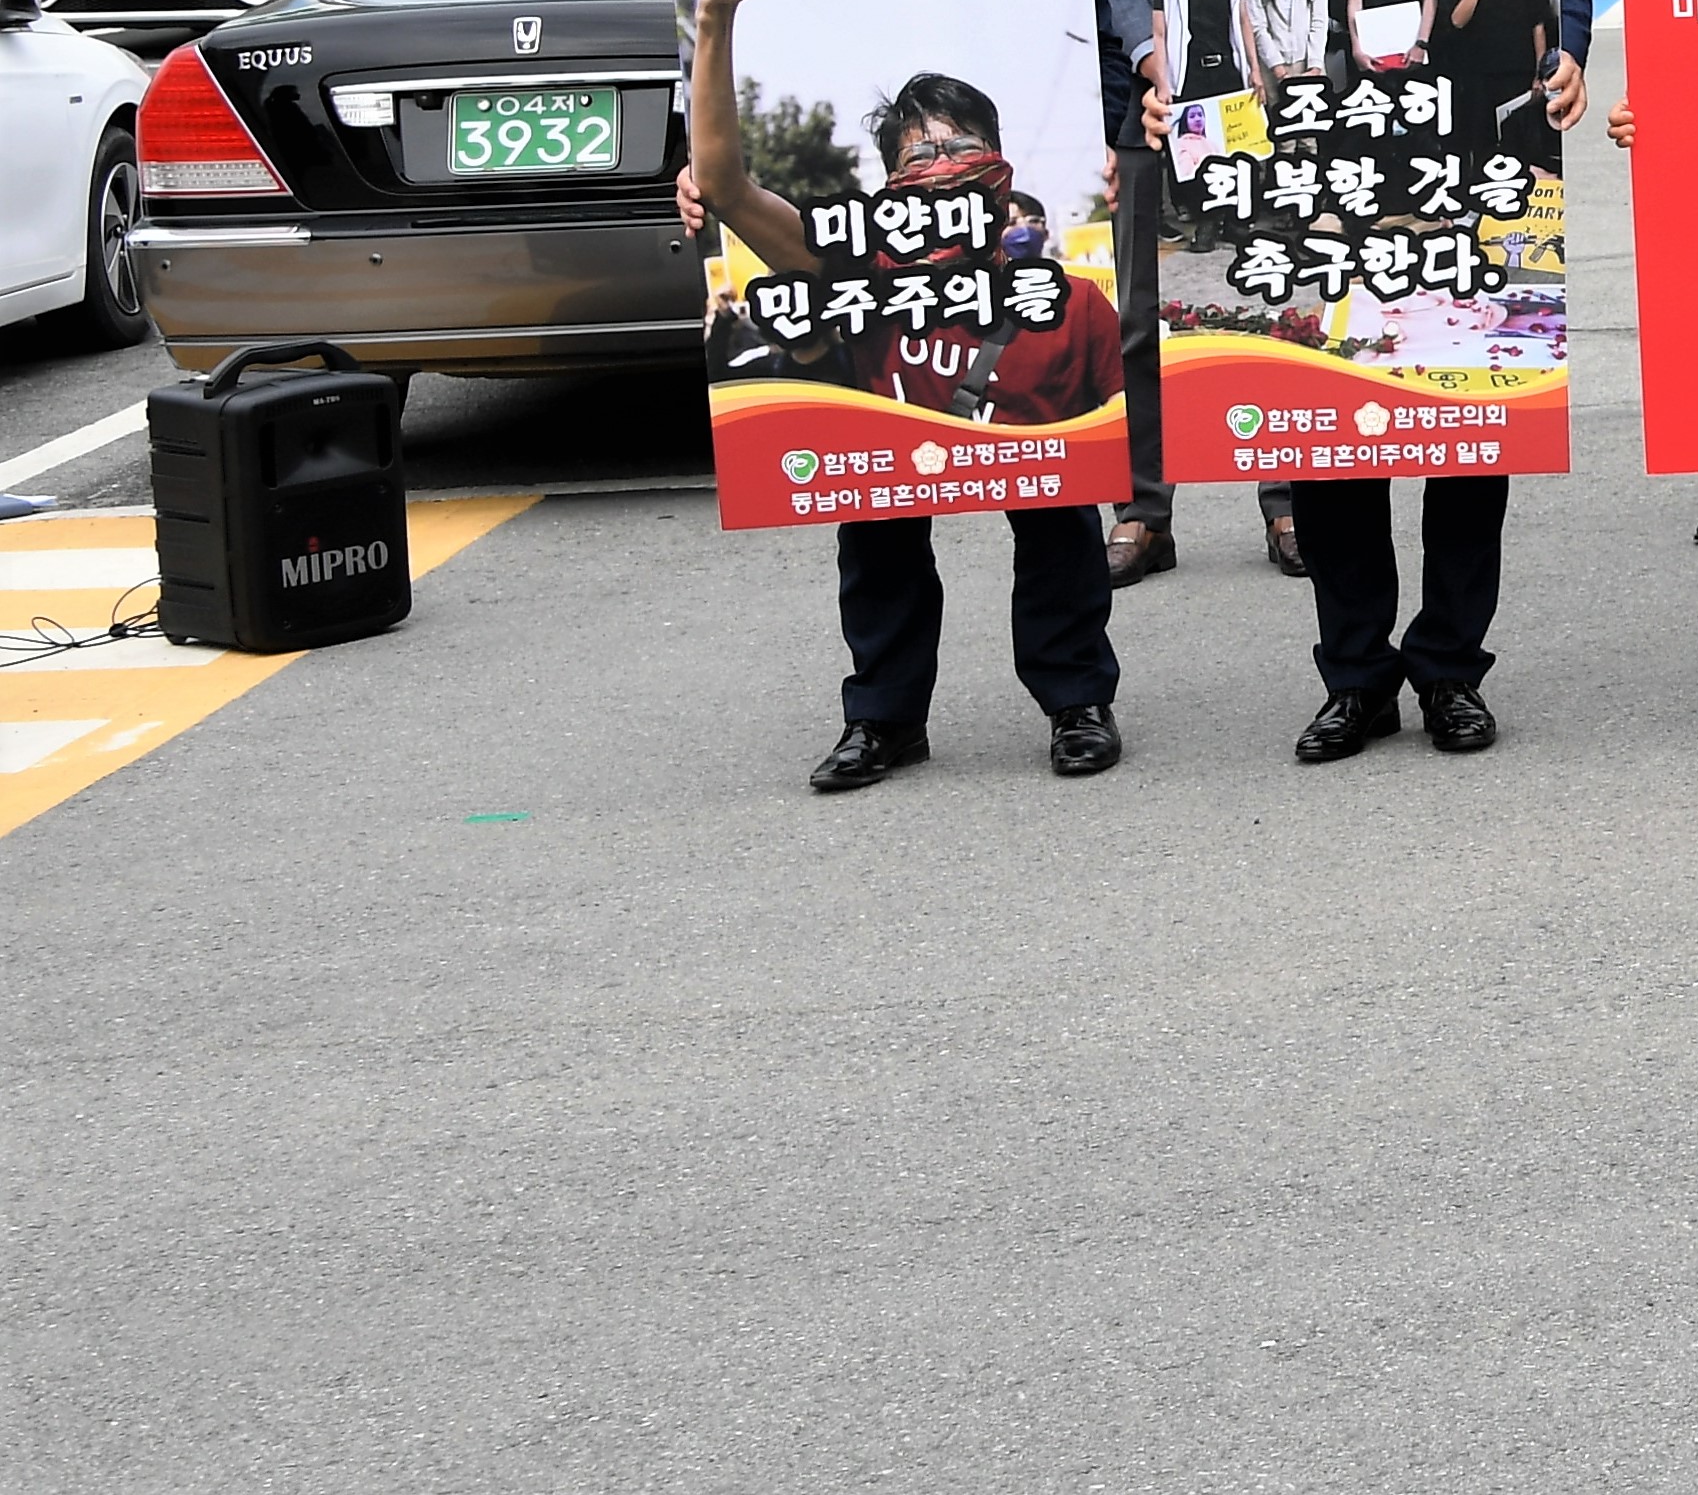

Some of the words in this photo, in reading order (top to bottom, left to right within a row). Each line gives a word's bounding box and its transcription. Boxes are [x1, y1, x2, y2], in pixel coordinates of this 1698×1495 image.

[238, 47, 313, 70] EQUUS
[495, 93, 576, 116] 04저
[1275, 77, 1451, 137] 조속히
[457, 116, 612, 168] 3932
[1203, 157, 1384, 218] 회복할
[1409, 154, 1530, 216] 것을
[1534, 187, 1564, 198] on't
[812, 193, 993, 256] 미얀마
[1527, 206, 1564, 220] TARY
[1235, 233, 1500, 300] 촉구한다.
[1268, 409, 1337, 432] 함평군
[1394, 405, 1506, 428] 함평군의회
[824, 450, 894, 475] 함평군
[952, 439, 1065, 466] 함평군의회
[1234, 448, 1302, 470] 동남아
[1312, 444, 1445, 467] 결혼이주여성
[1457, 442, 1500, 463] 일동
[792, 489, 861, 514] 동남아
[870, 479, 1006, 507] 결혼이주여성
[1017, 475, 1061, 497] 일동
[281, 537, 389, 589] MIPRO
